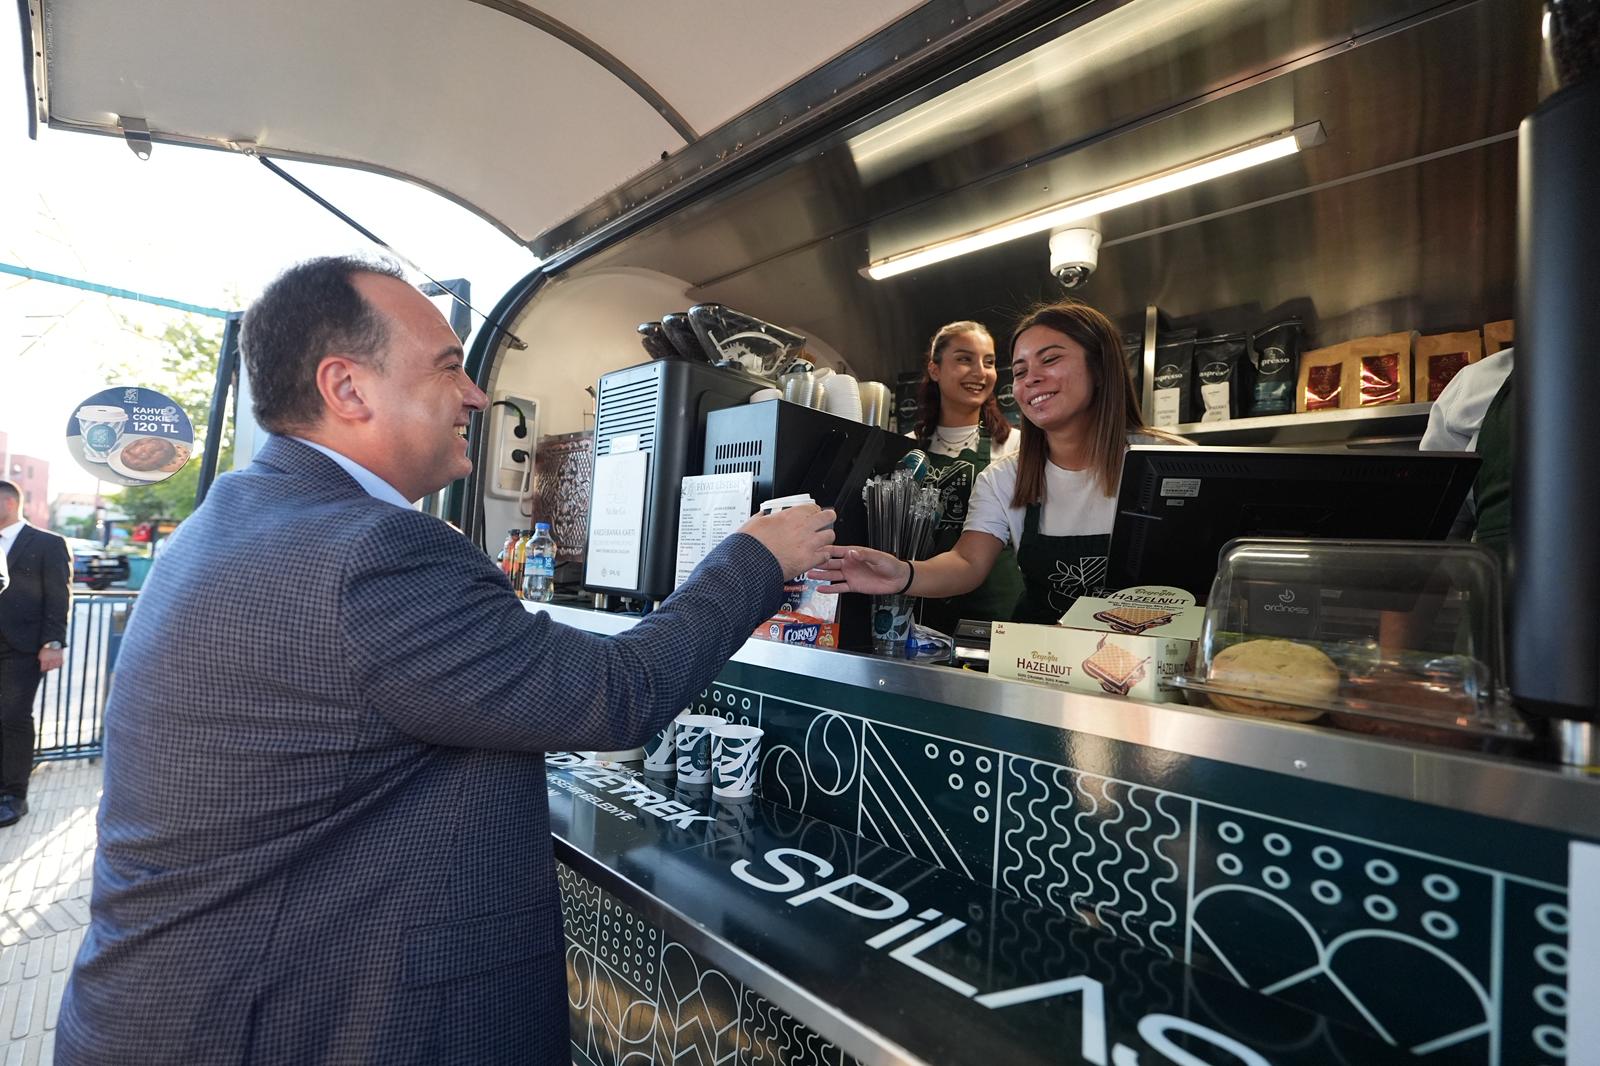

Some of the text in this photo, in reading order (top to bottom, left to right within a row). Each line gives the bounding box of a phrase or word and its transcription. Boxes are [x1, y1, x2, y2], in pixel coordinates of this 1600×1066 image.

[133, 422, 179, 433] 120 TL
[1112, 593, 1189, 605] HAZELNUT
[784, 626, 818, 642] CORNY
[1016, 657, 1073, 677] HAZELNUT
[568, 765, 717, 830] ZEYREK
